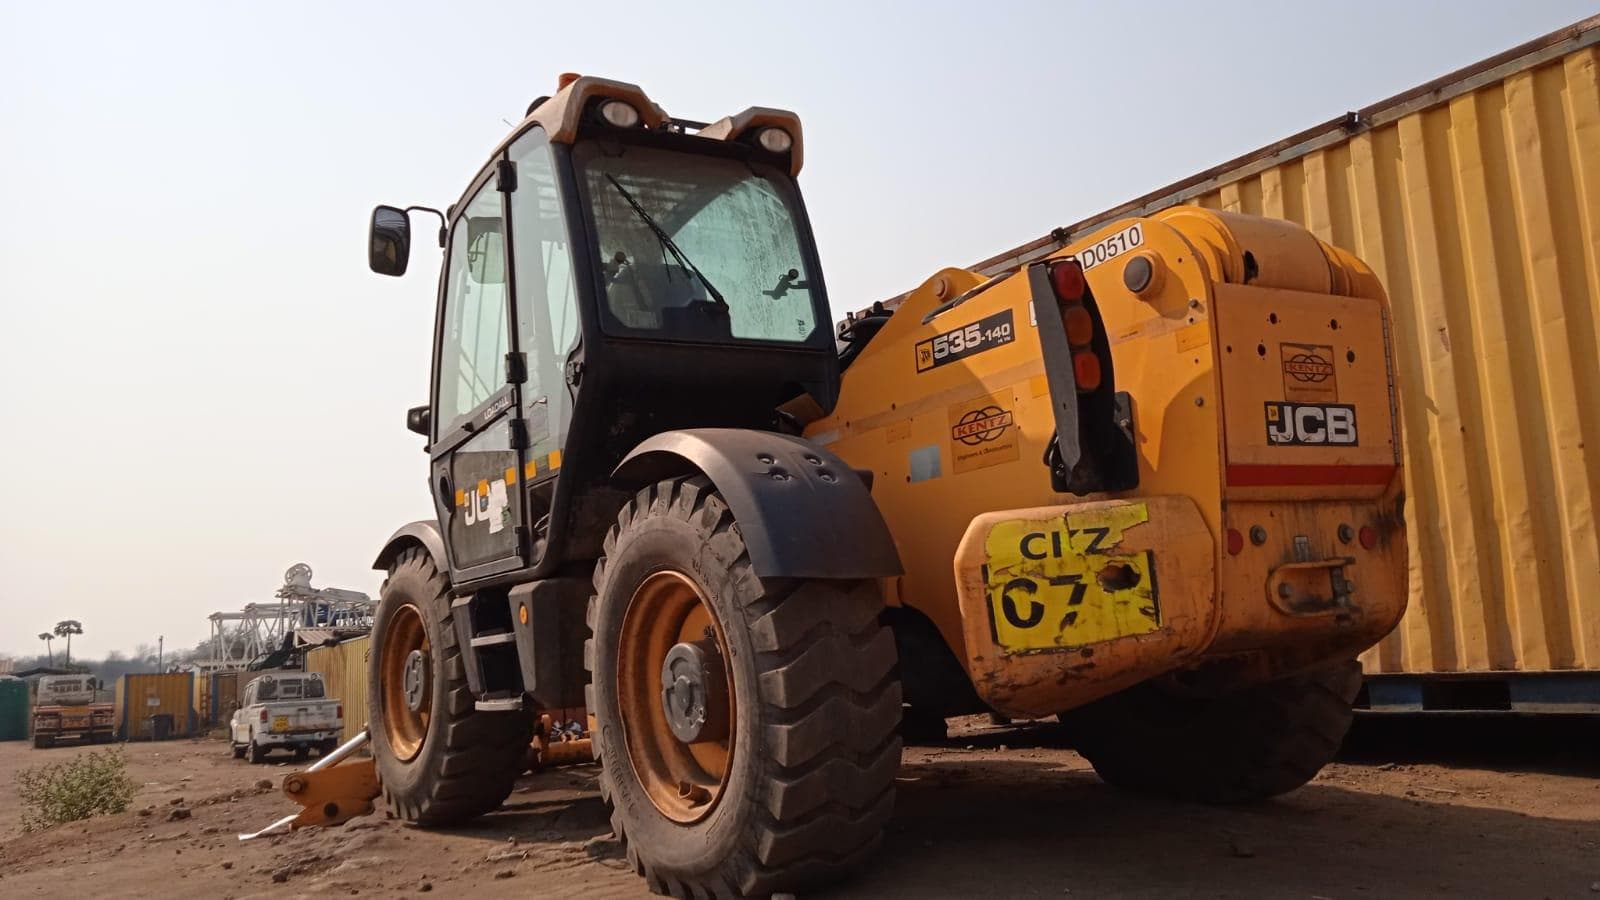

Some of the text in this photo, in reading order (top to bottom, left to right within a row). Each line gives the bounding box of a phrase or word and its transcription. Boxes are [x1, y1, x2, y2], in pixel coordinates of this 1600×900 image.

[1289, 363, 1330, 374] KENTZ
[957, 415, 1006, 436] KENTZ
[1267, 405, 1356, 443] JCB
